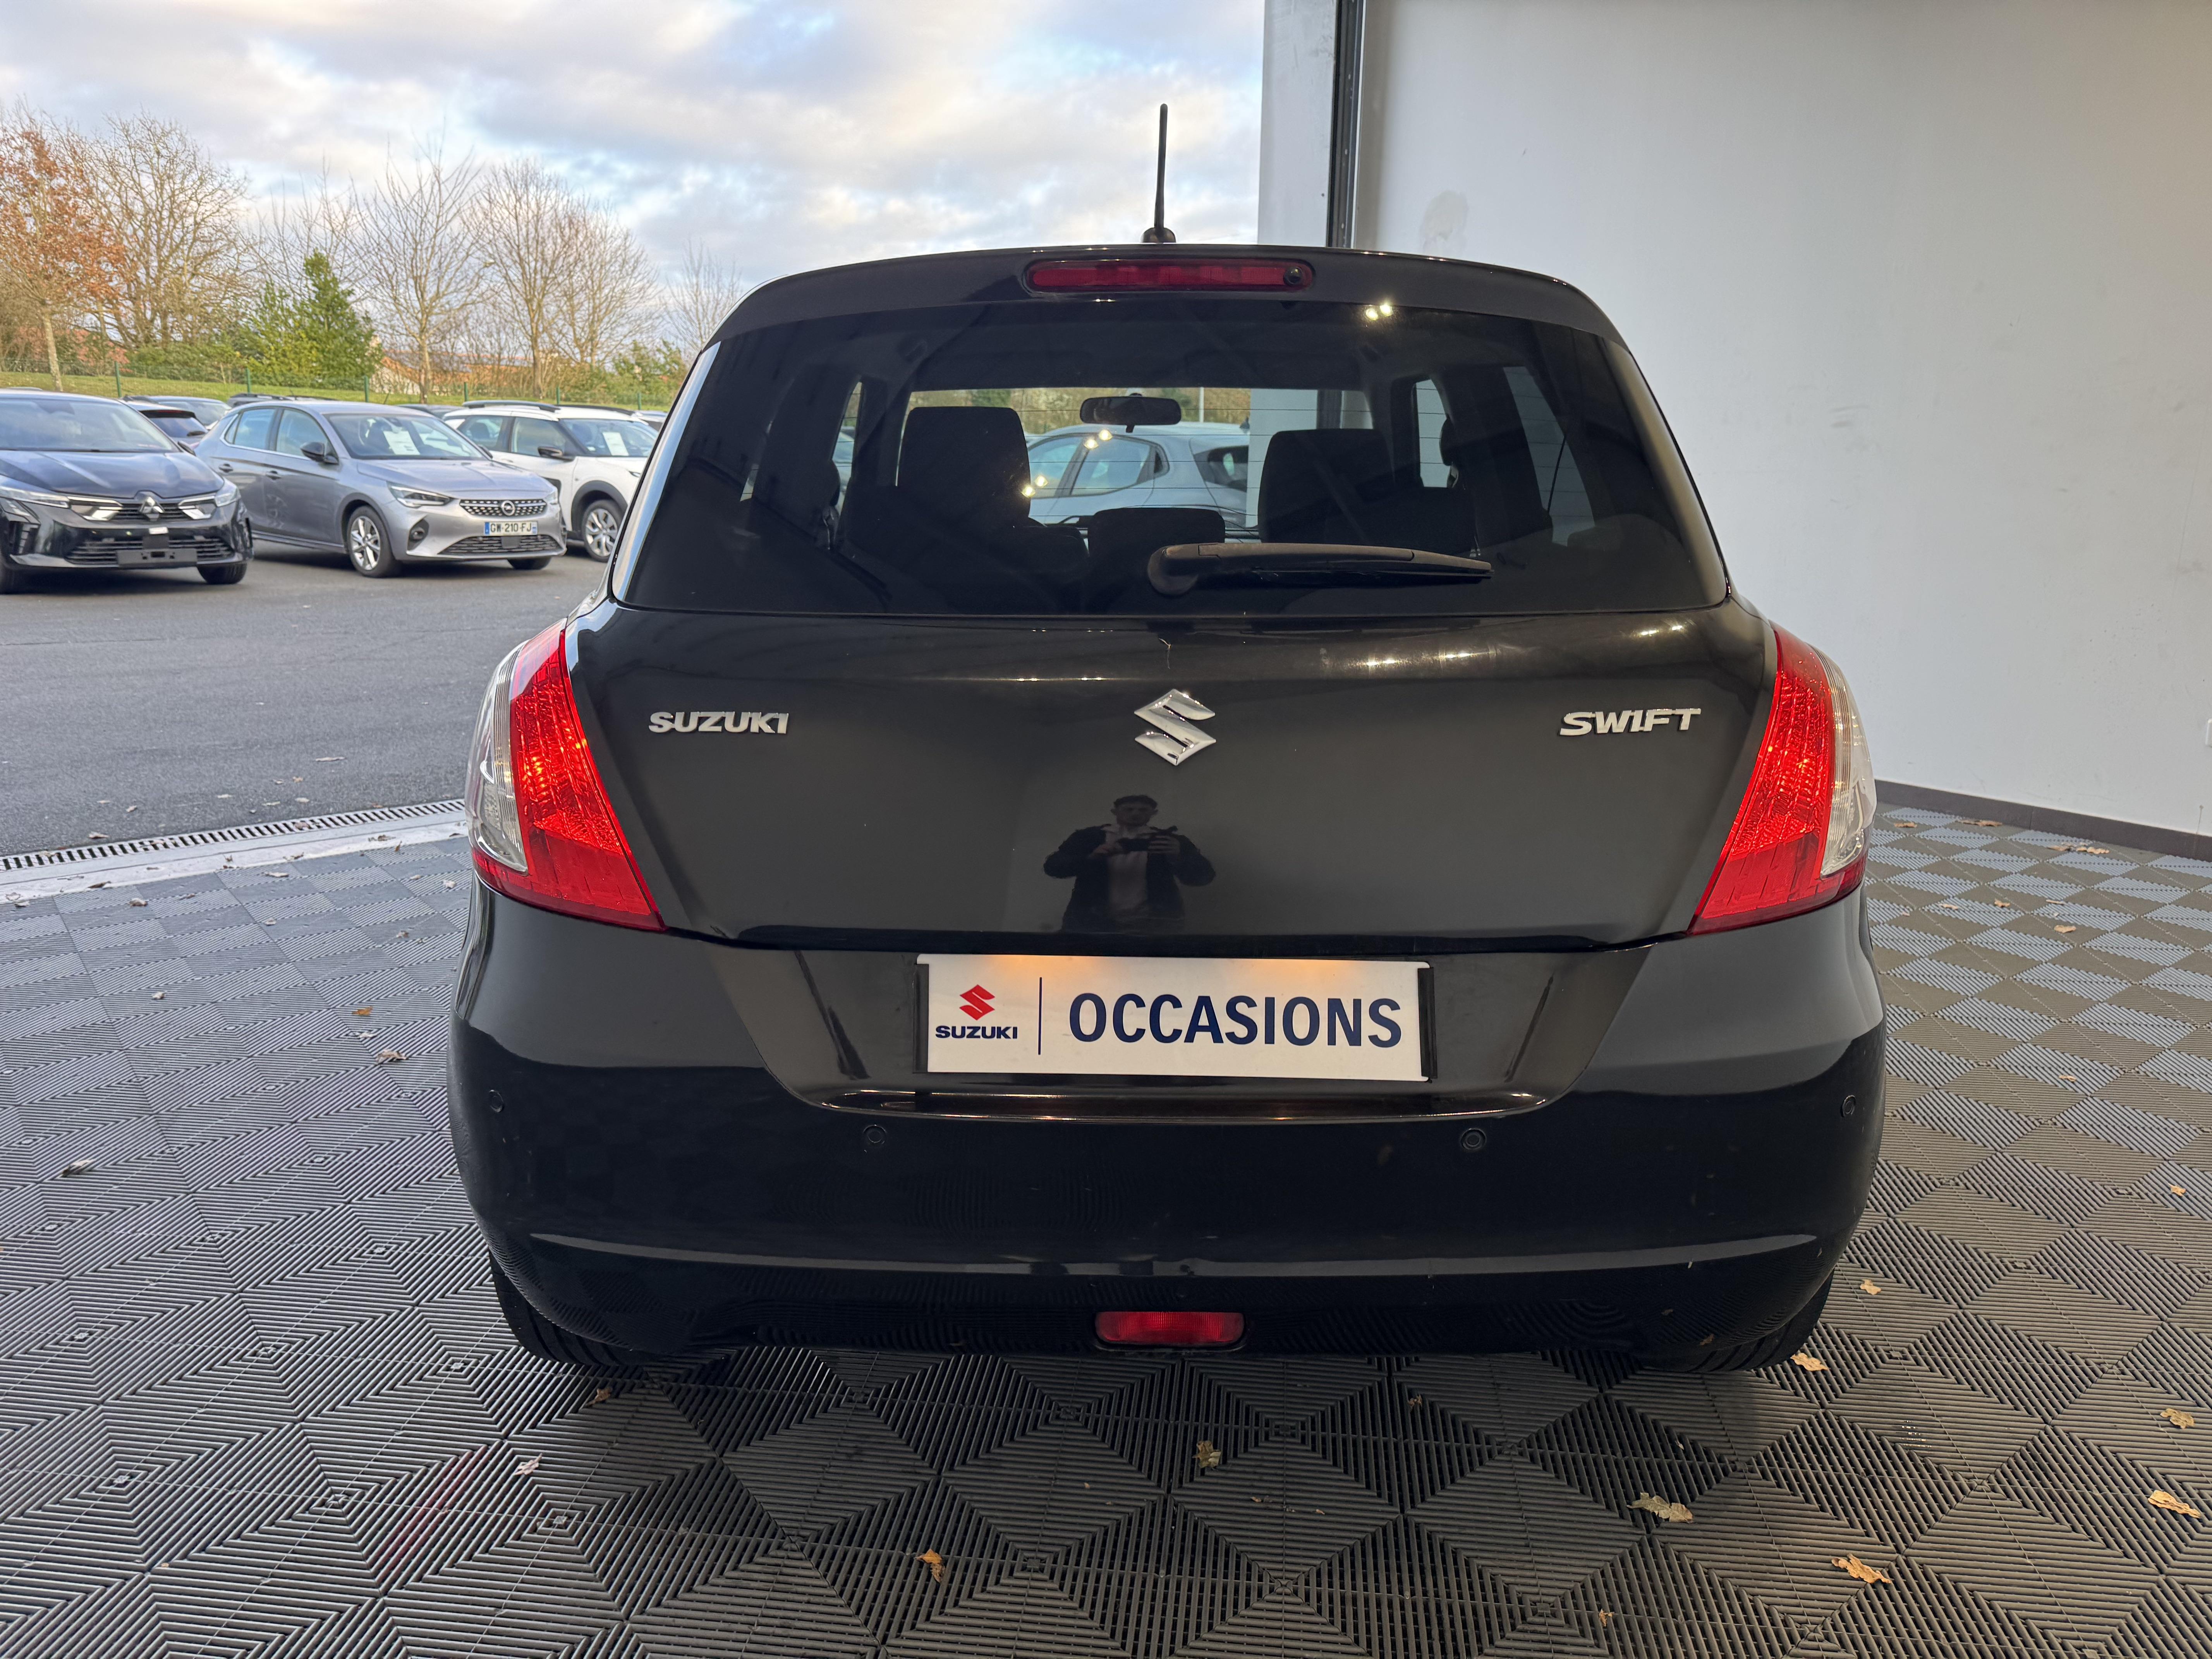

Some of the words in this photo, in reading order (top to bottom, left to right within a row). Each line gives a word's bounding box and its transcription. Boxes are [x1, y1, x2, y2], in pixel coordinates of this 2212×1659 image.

[490, 523, 532, 532] GW-210-FJ
[648, 711, 789, 734] SUZUKI
[1559, 708, 1701, 736] SWIFT
[935, 1025, 1018, 1039] SUZUKI
[1069, 993, 1402, 1048] OCCASIONS
